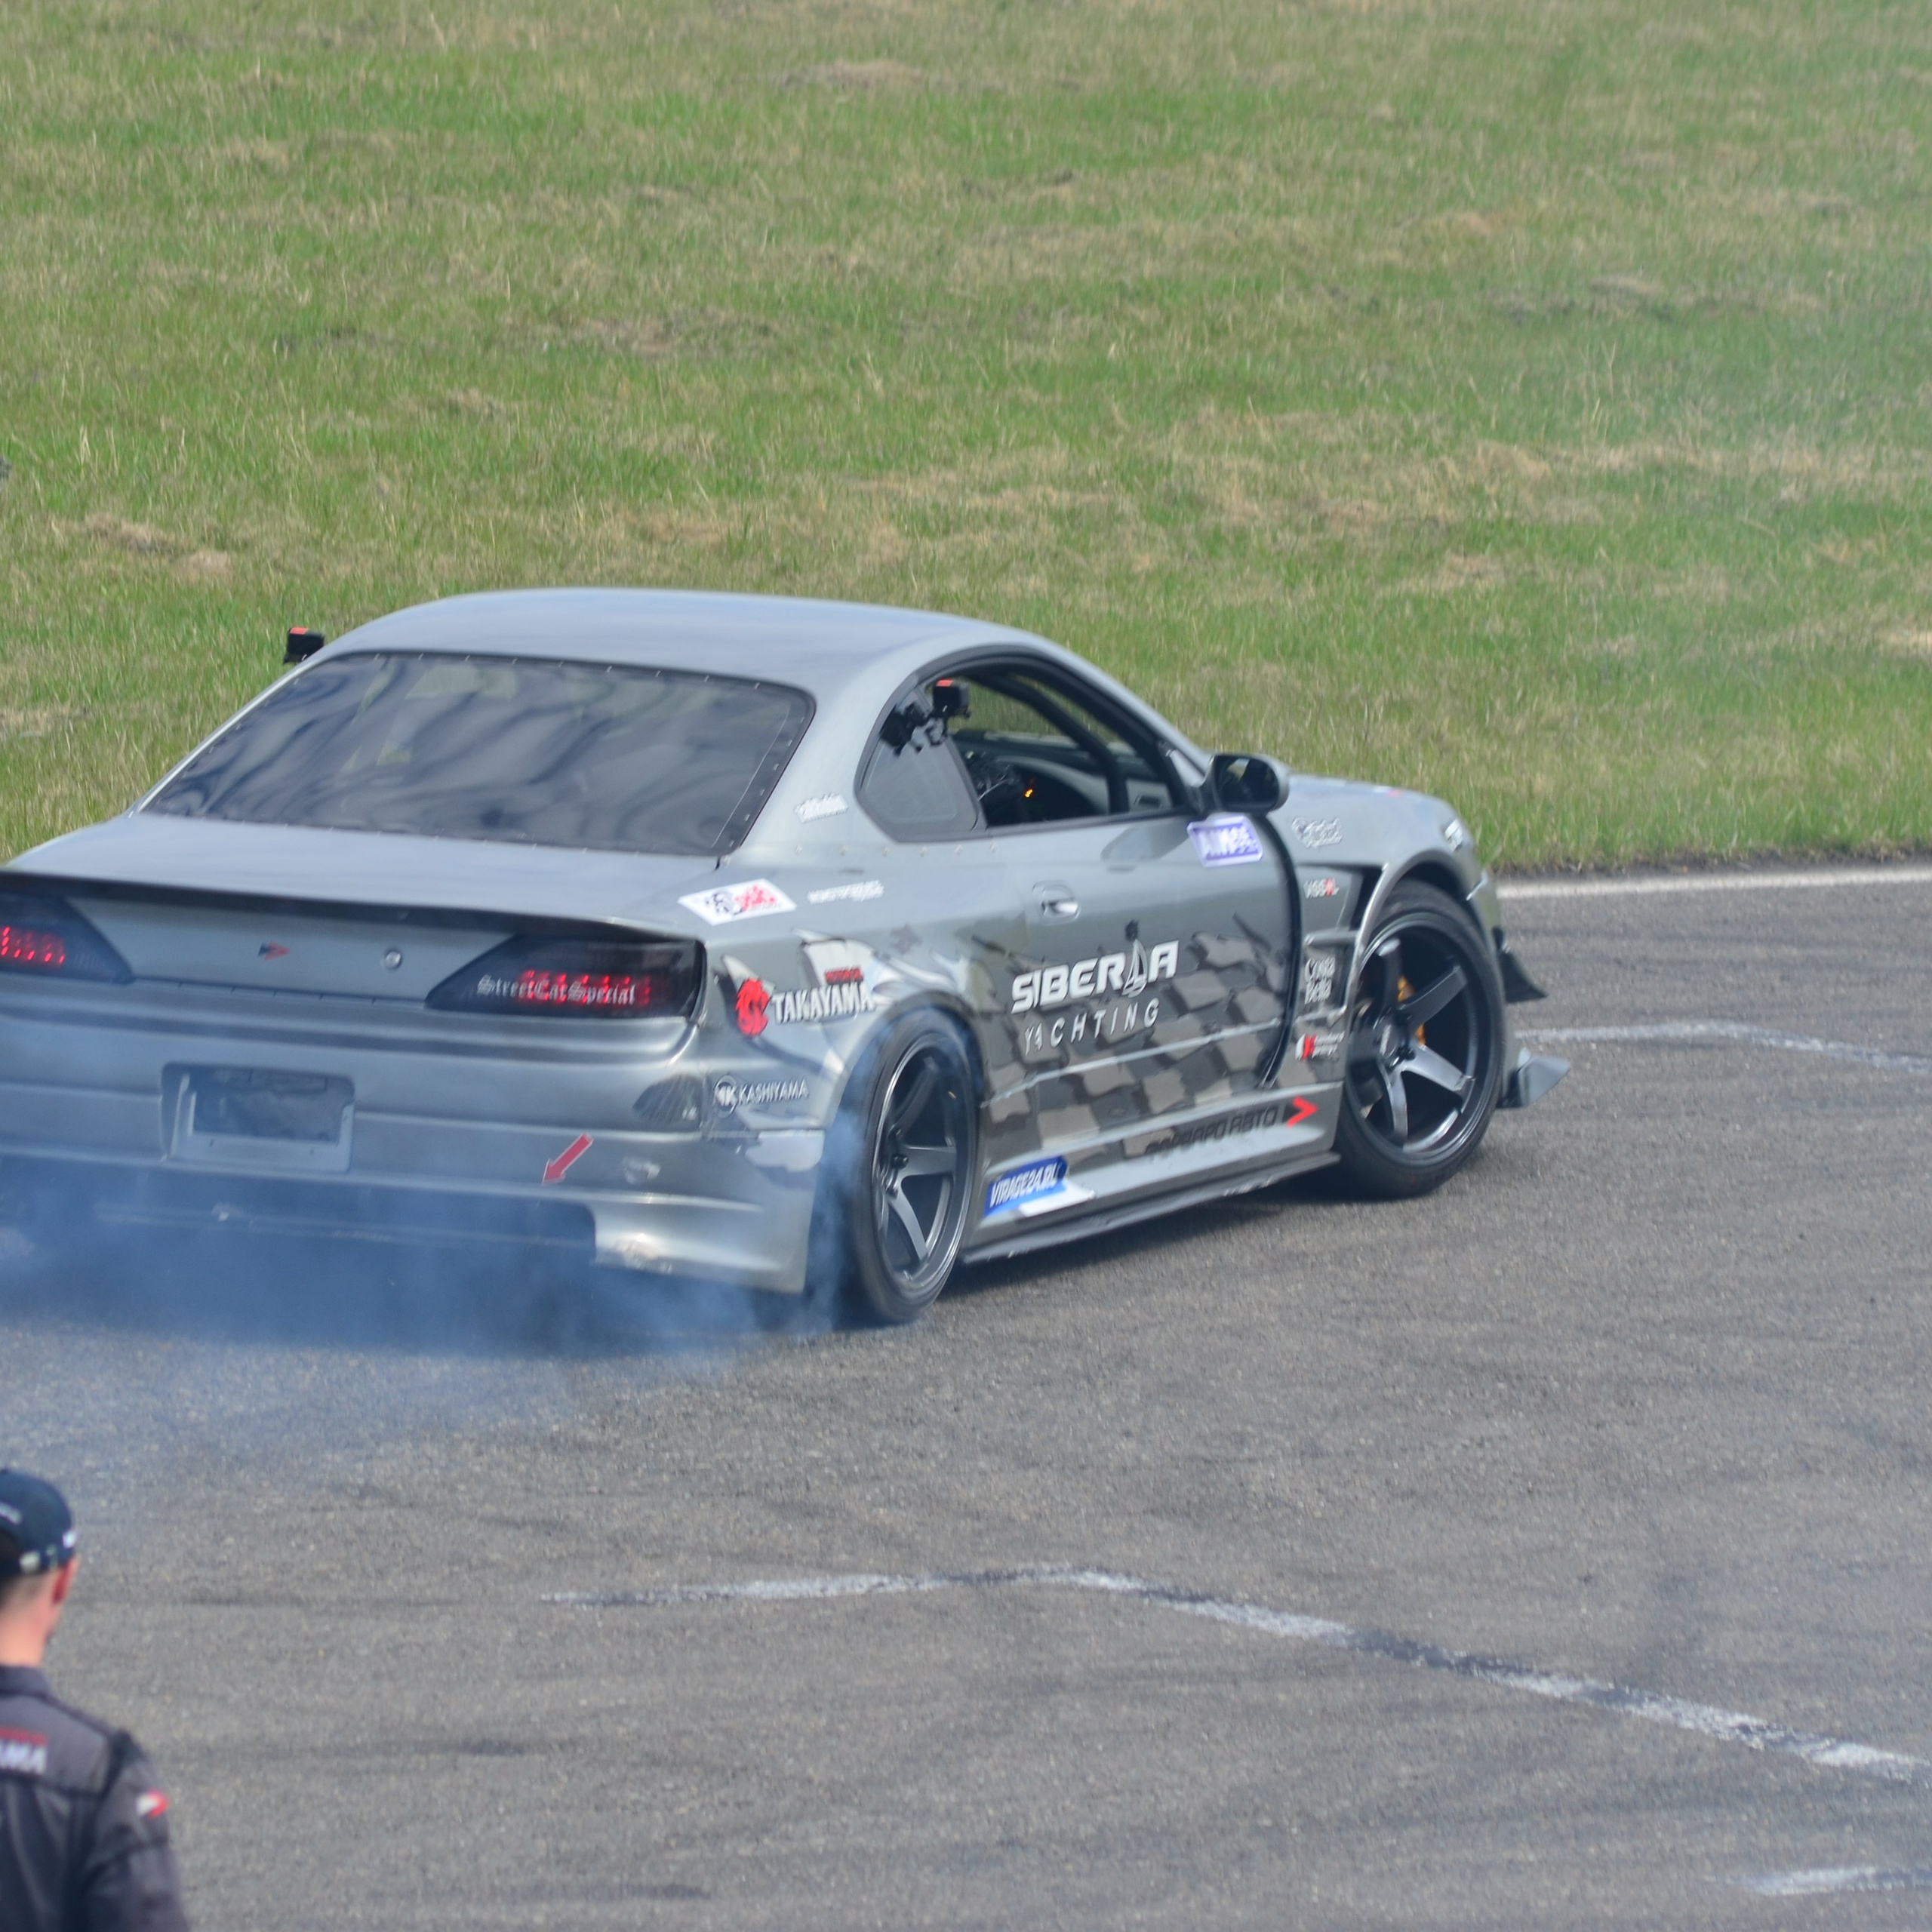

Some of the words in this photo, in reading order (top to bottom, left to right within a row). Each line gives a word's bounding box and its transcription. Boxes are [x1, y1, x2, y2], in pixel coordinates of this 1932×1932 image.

[771, 982, 875, 1024] TAKAYAMA
[1024, 998, 1159, 1056] YACHTING
[739, 1078, 810, 1104] KASHIYAMA
